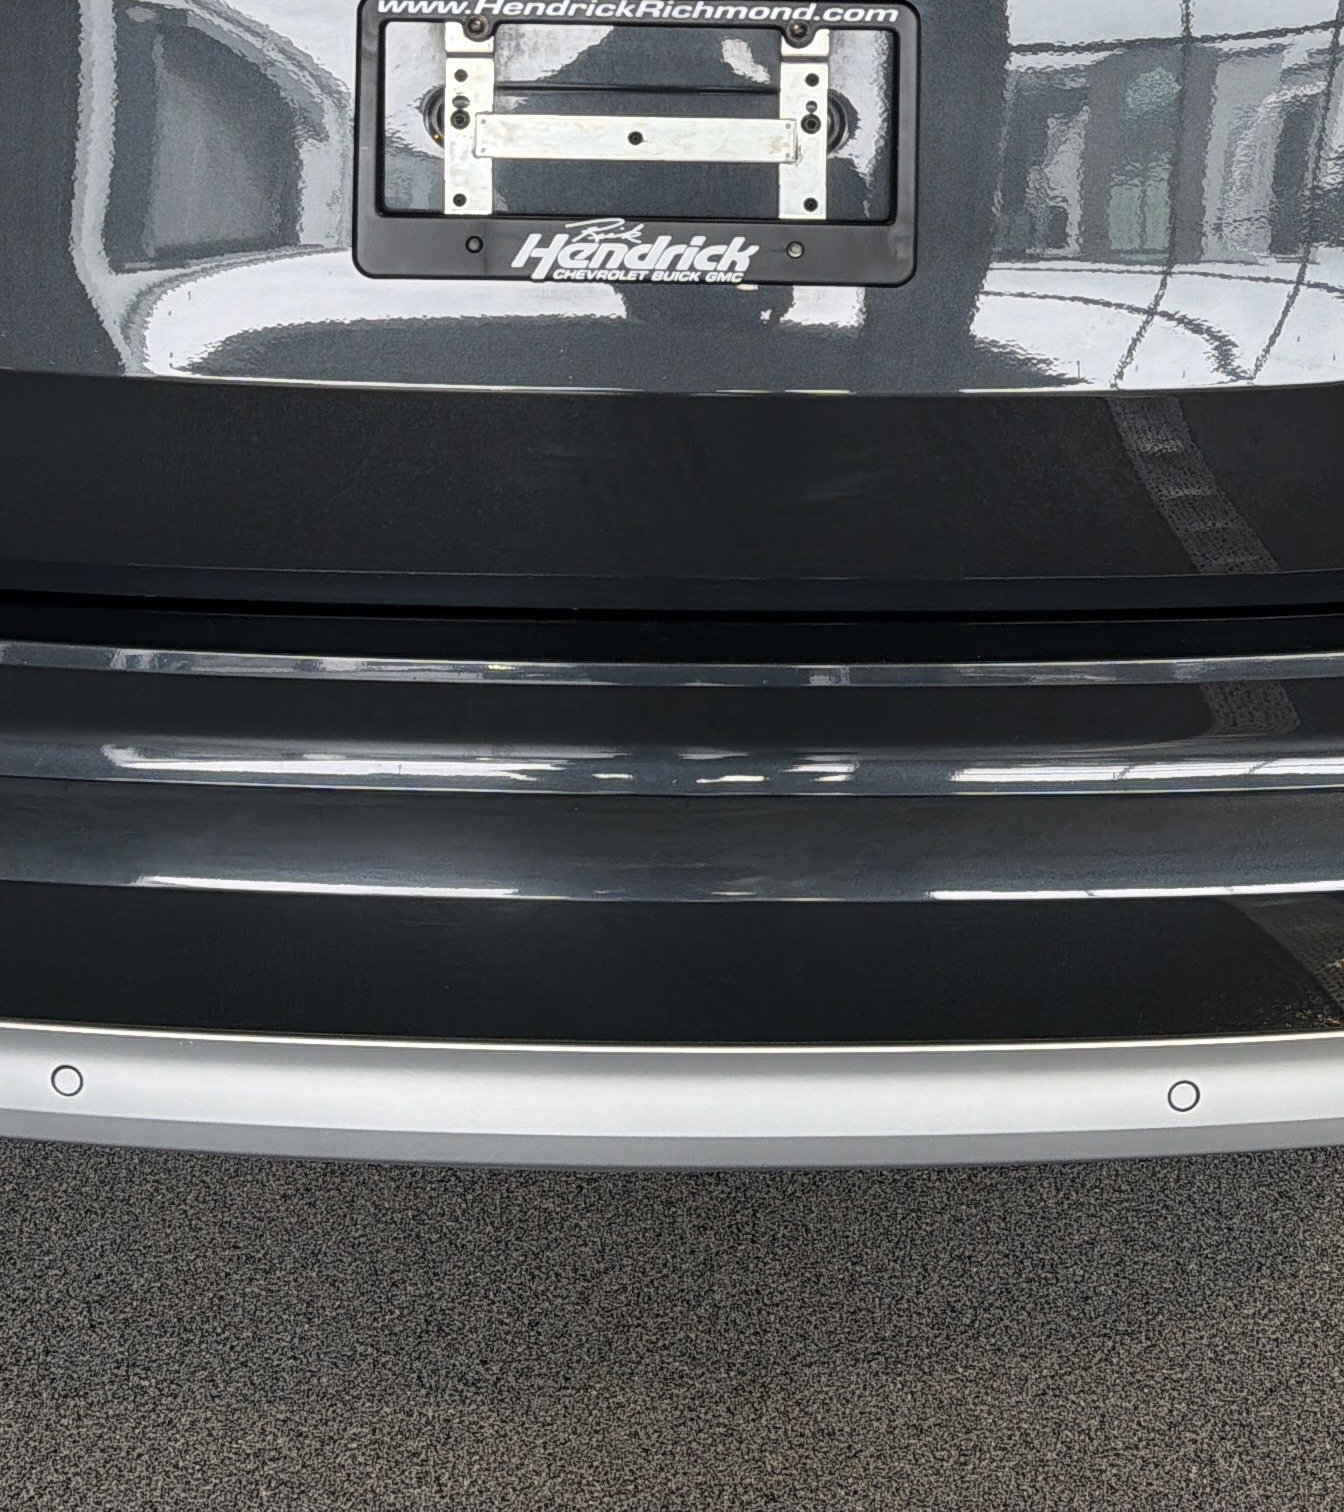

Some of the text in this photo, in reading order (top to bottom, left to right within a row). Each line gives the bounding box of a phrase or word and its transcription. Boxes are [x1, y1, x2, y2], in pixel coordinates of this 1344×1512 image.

[511, 233, 760, 280] Hendrick
[553, 269, 745, 283] CHEVROLET BUICK GMC
